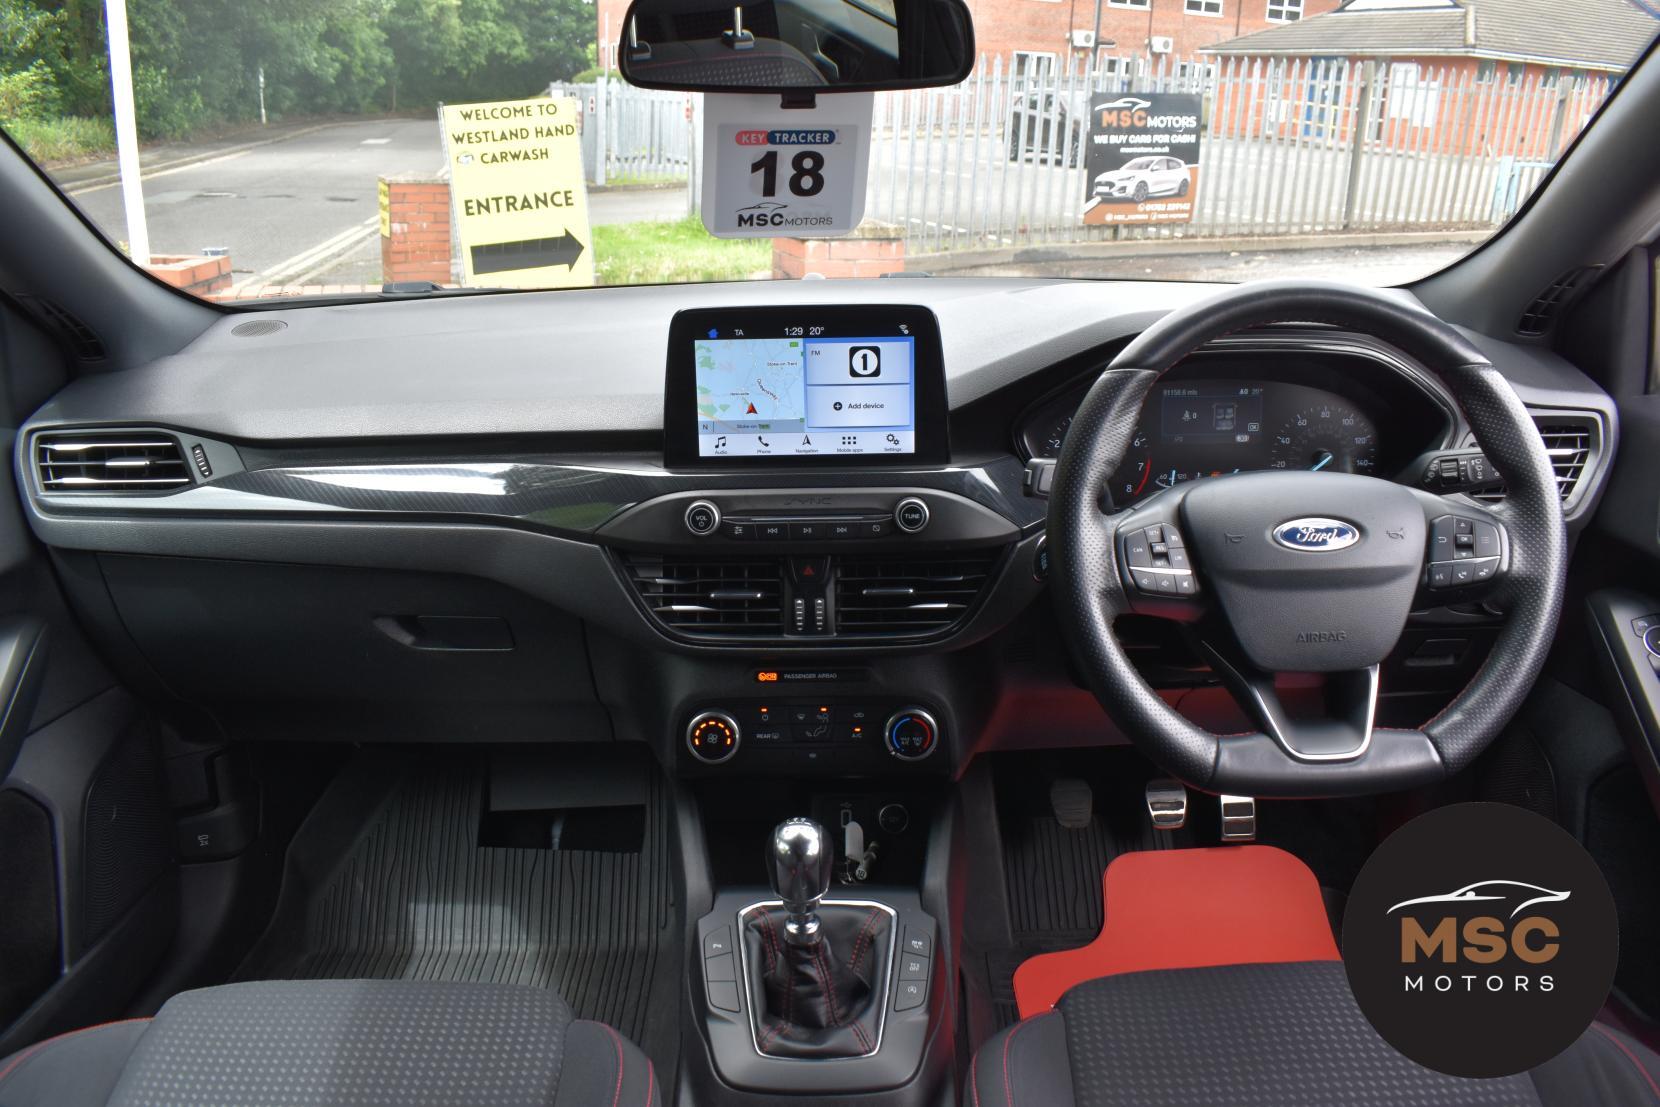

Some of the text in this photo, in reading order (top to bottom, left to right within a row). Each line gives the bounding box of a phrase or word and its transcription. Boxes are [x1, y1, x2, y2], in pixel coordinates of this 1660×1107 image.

[460, 103, 558, 121] WELCOME TO
[452, 124, 575, 144] WESTLAND HAND
[741, 132, 830, 144] KEY TRACKER
[1094, 134, 1109, 144] WE
[1110, 134, 1128, 144] BUY
[1129, 134, 1152, 144] CARS
[1153, 133, 1170, 143] FOR
[480, 147, 549, 164] CARWASH
[750, 150, 825, 198] 18
[464, 190, 574, 217] ENTRANCE
[734, 328, 744, 336] TA
[784, 326, 825, 336] 1:29 20°
[1342, 418, 1354, 426] 100
[1054, 439, 1061, 448] 2
[1134, 438, 1140, 447] 6
[1281, 437, 1290, 445] 40
[1355, 437, 1366, 445] 120
[1138, 462, 1144, 471] 7
[1276, 460, 1286, 468] 20
[1357, 459, 1368, 467] 140
[1126, 484, 1132, 493] 8
[1296, 525, 1339, 544] Ford
[1295, 630, 1347, 644] AIRBAG
